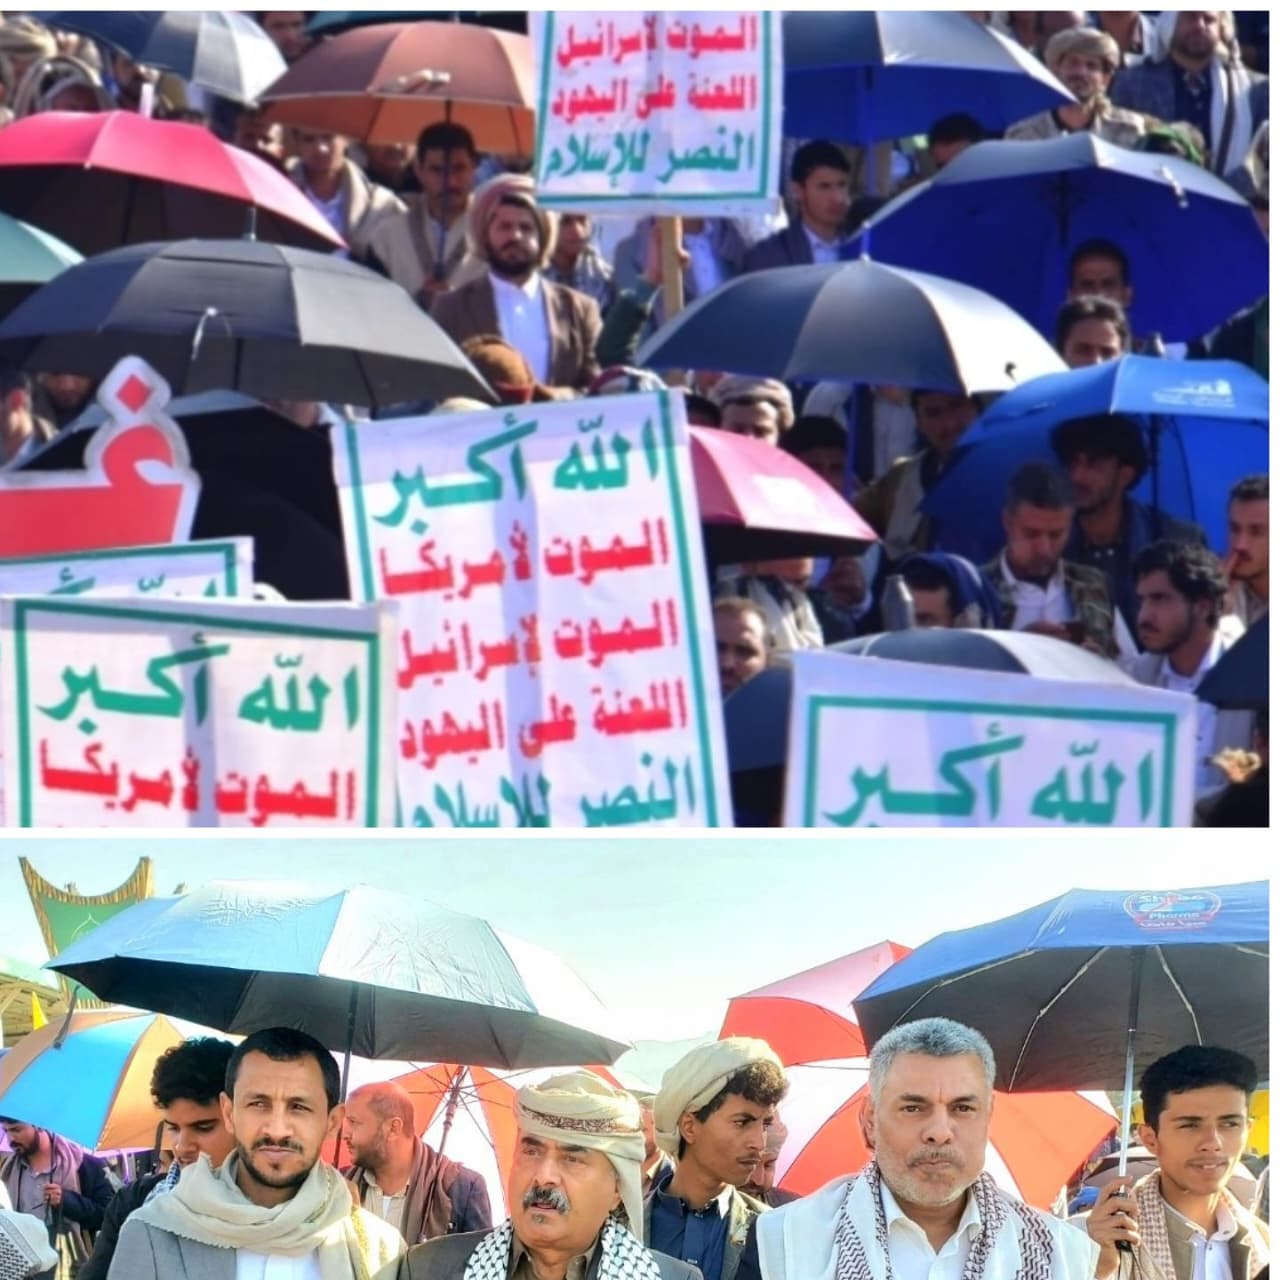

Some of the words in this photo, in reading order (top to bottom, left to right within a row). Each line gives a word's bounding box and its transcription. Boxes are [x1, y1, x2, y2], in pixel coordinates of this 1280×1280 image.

[666, 14, 758, 60] الموت
[552, 77, 628, 126] اليهود
[636, 74, 677, 121] على
[687, 72, 758, 111] اللعنة
[655, 125, 756, 184] النصر
[372, 412, 539, 535] أكبر
[553, 413, 660, 492] الله
[543, 517, 669, 587] الموت
[553, 598, 679, 668] الموت
[36, 633, 231, 735] أكبر
[237, 653, 360, 732] الله
[591, 677, 688, 738] اللعنة
[399, 698, 505, 770] اليهود
[520, 694, 577, 759] على
[213, 770, 356, 827] الموت
[823, 721, 1025, 827] أكبر
[1030, 740, 1155, 826] الله
